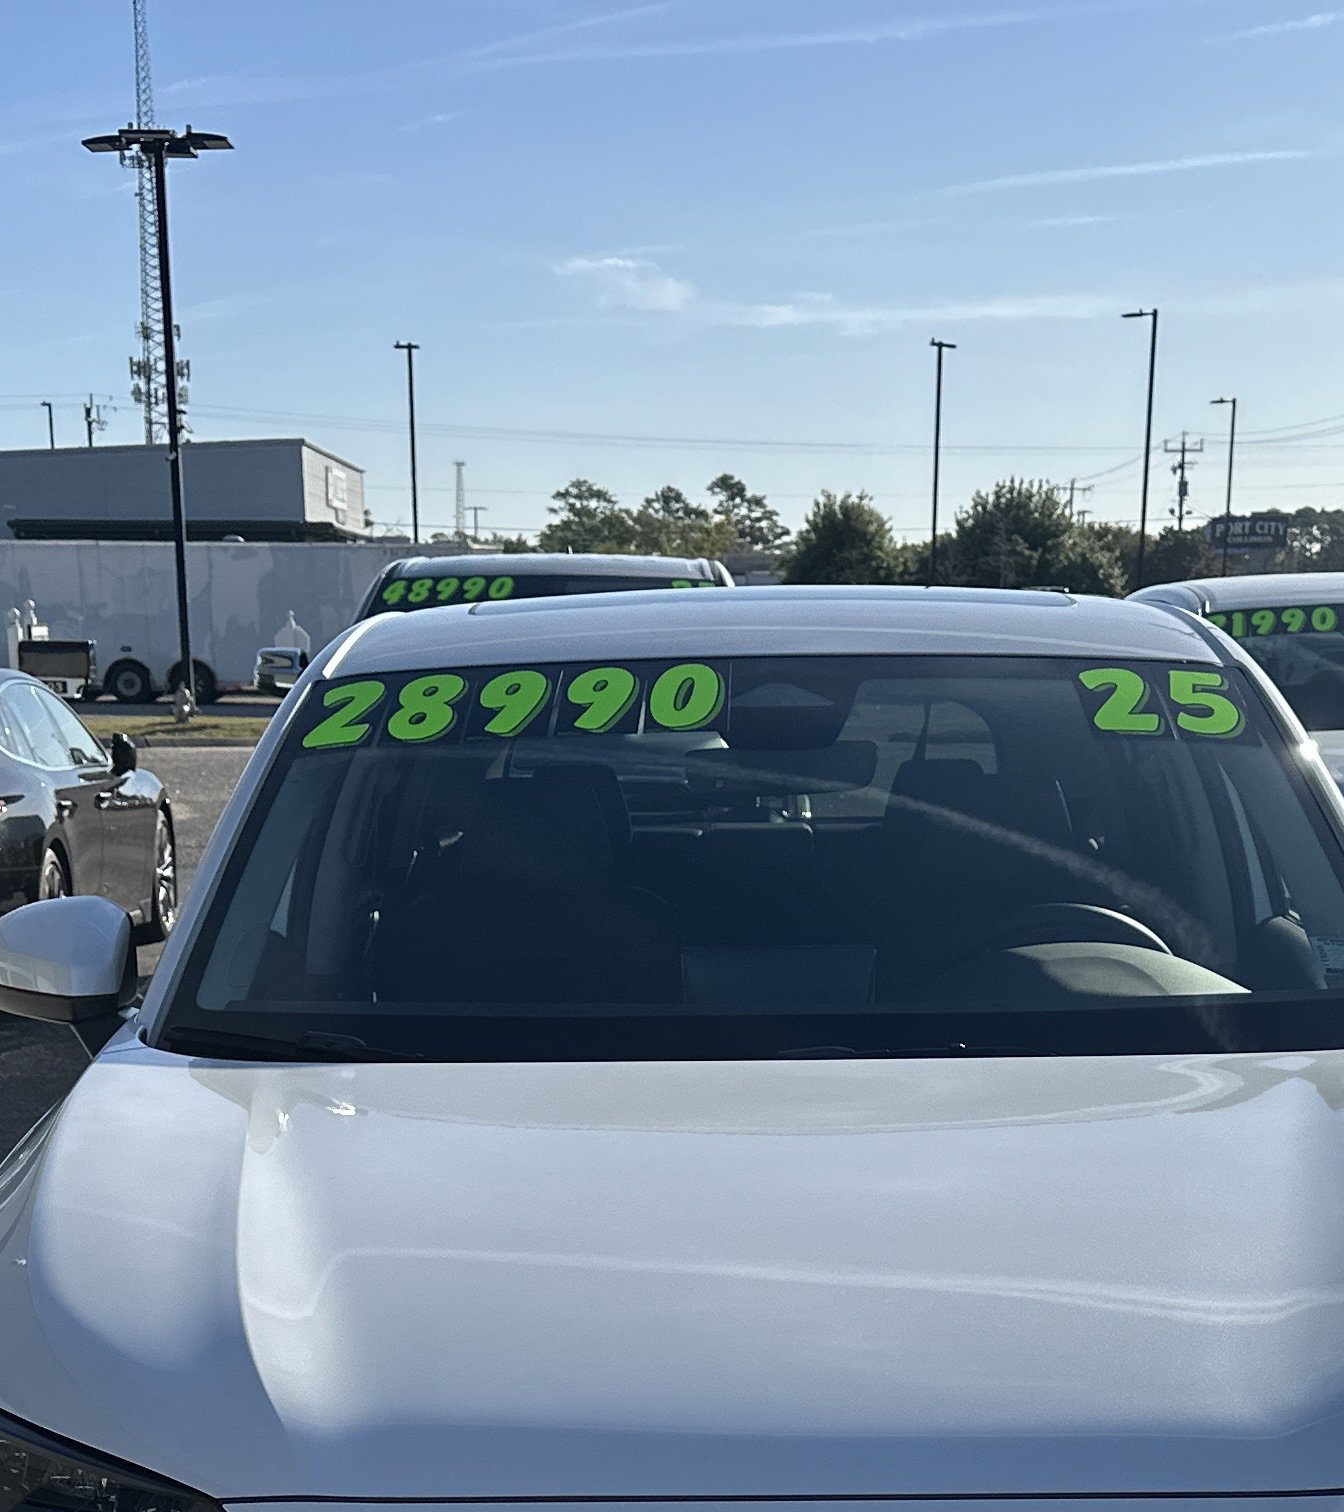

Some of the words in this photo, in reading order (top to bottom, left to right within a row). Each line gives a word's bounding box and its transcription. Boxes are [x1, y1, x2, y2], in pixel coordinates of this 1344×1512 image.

[1256, 520, 1287, 536] CITY
[382, 577, 514, 605] 48990
[302, 662, 726, 748] 28990
[1078, 668, 1247, 739] 25
